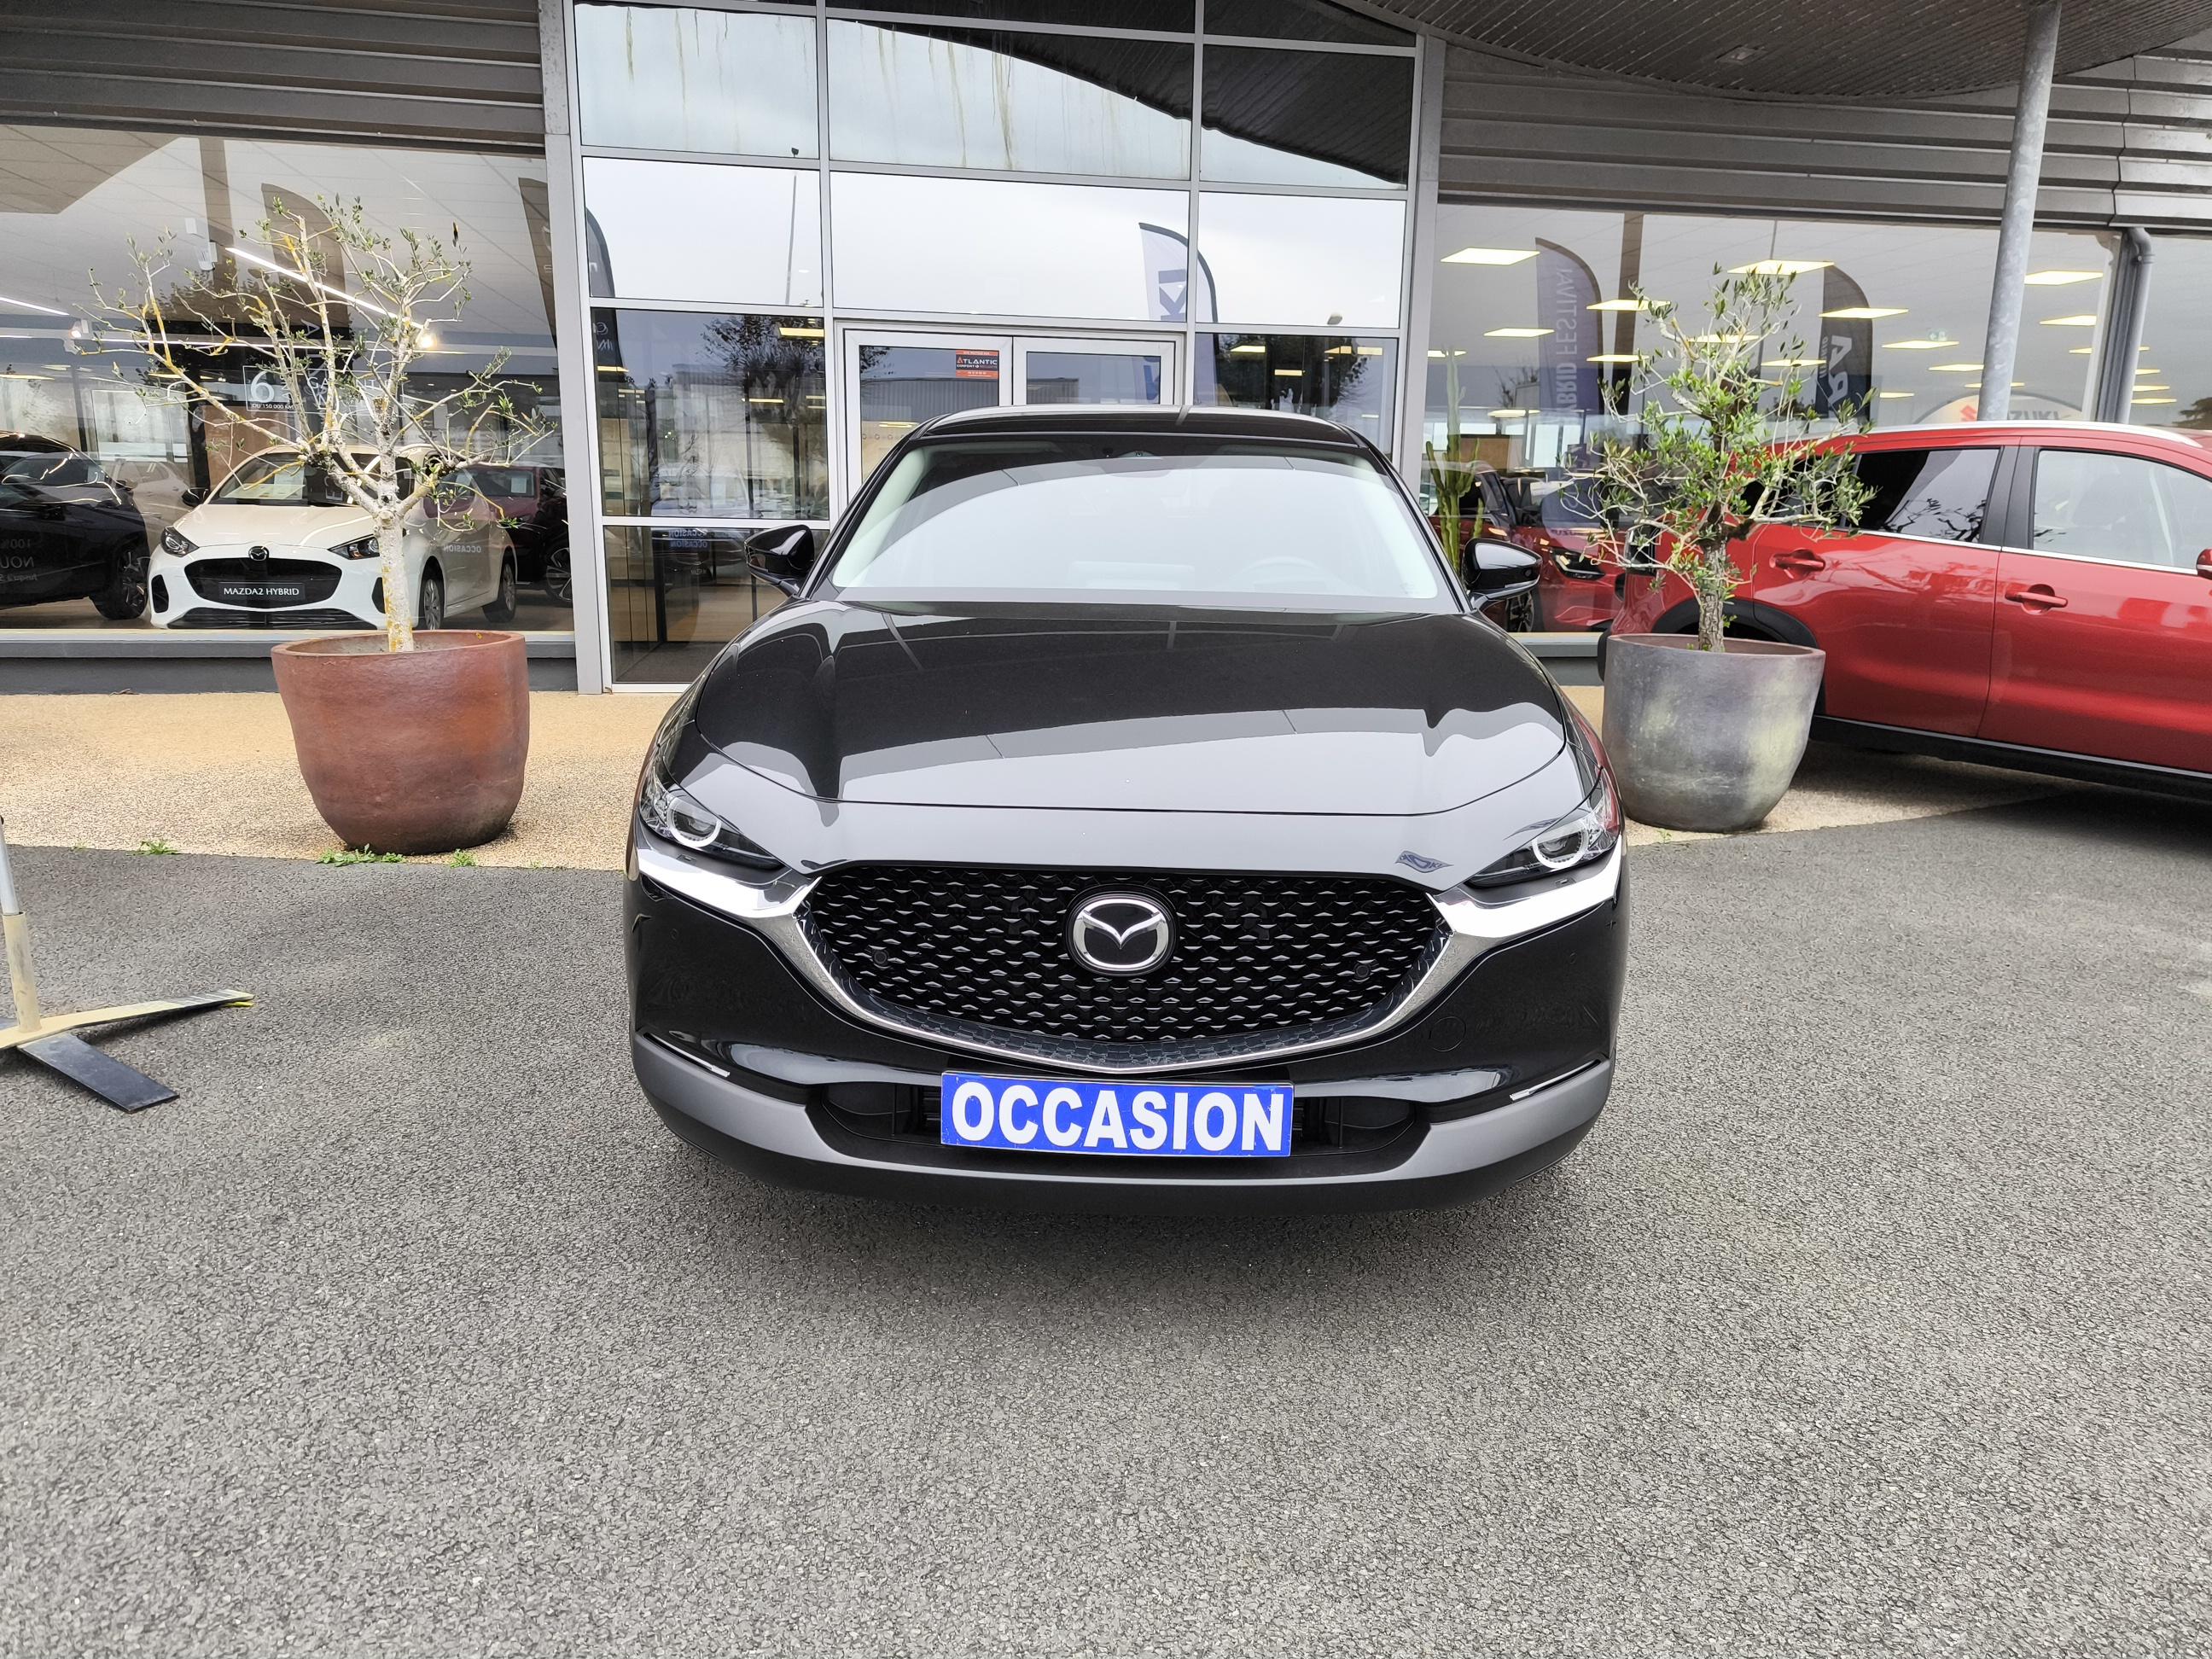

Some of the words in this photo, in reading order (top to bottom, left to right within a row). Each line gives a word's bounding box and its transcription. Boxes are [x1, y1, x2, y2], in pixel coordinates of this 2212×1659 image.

[957, 356, 998, 365] ATLANTIC
[250, 370, 275, 403] 6
[224, 587, 265, 596] MAZDA2
[952, 1081, 1284, 1152] OCCASION
